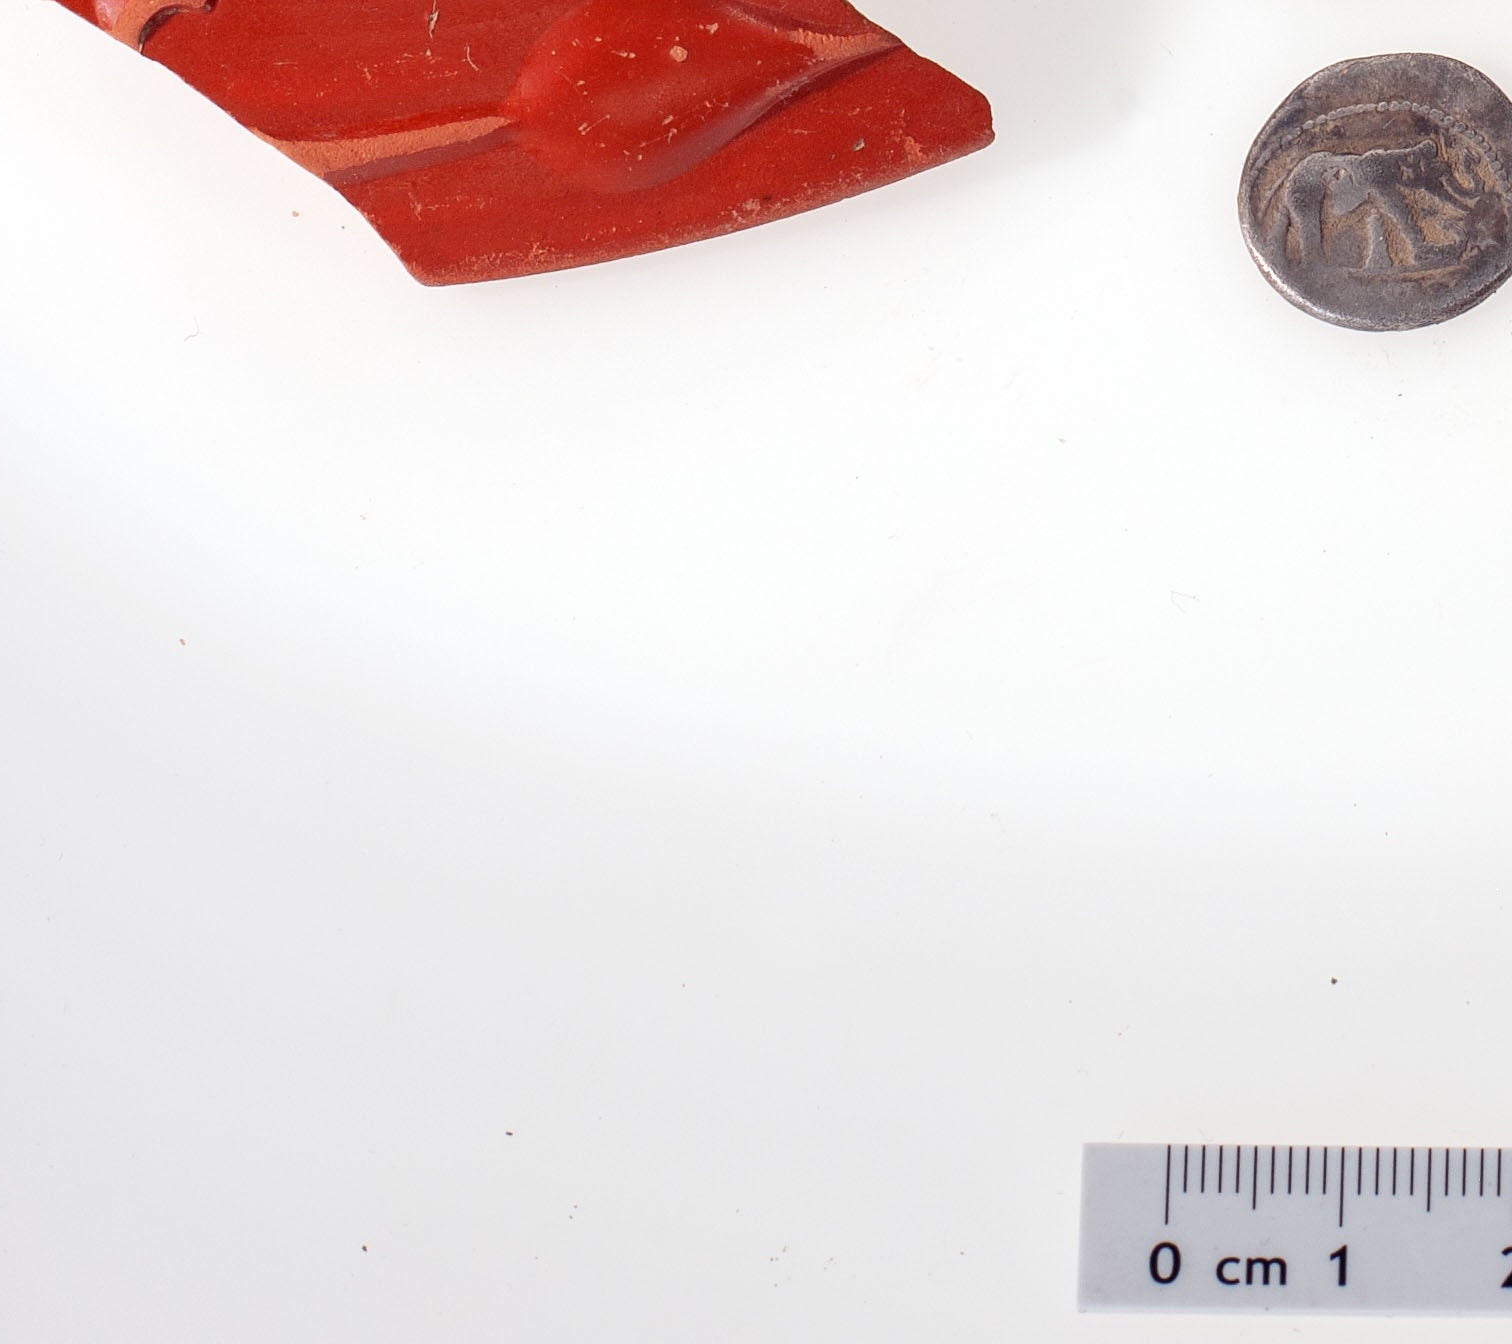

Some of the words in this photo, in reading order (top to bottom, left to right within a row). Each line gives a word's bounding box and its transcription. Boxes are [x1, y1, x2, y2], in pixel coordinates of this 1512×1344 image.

[1148, 1241, 1182, 1285] 0
[1215, 1256, 1288, 1286] cm
[1329, 1244, 1348, 1287] 1
